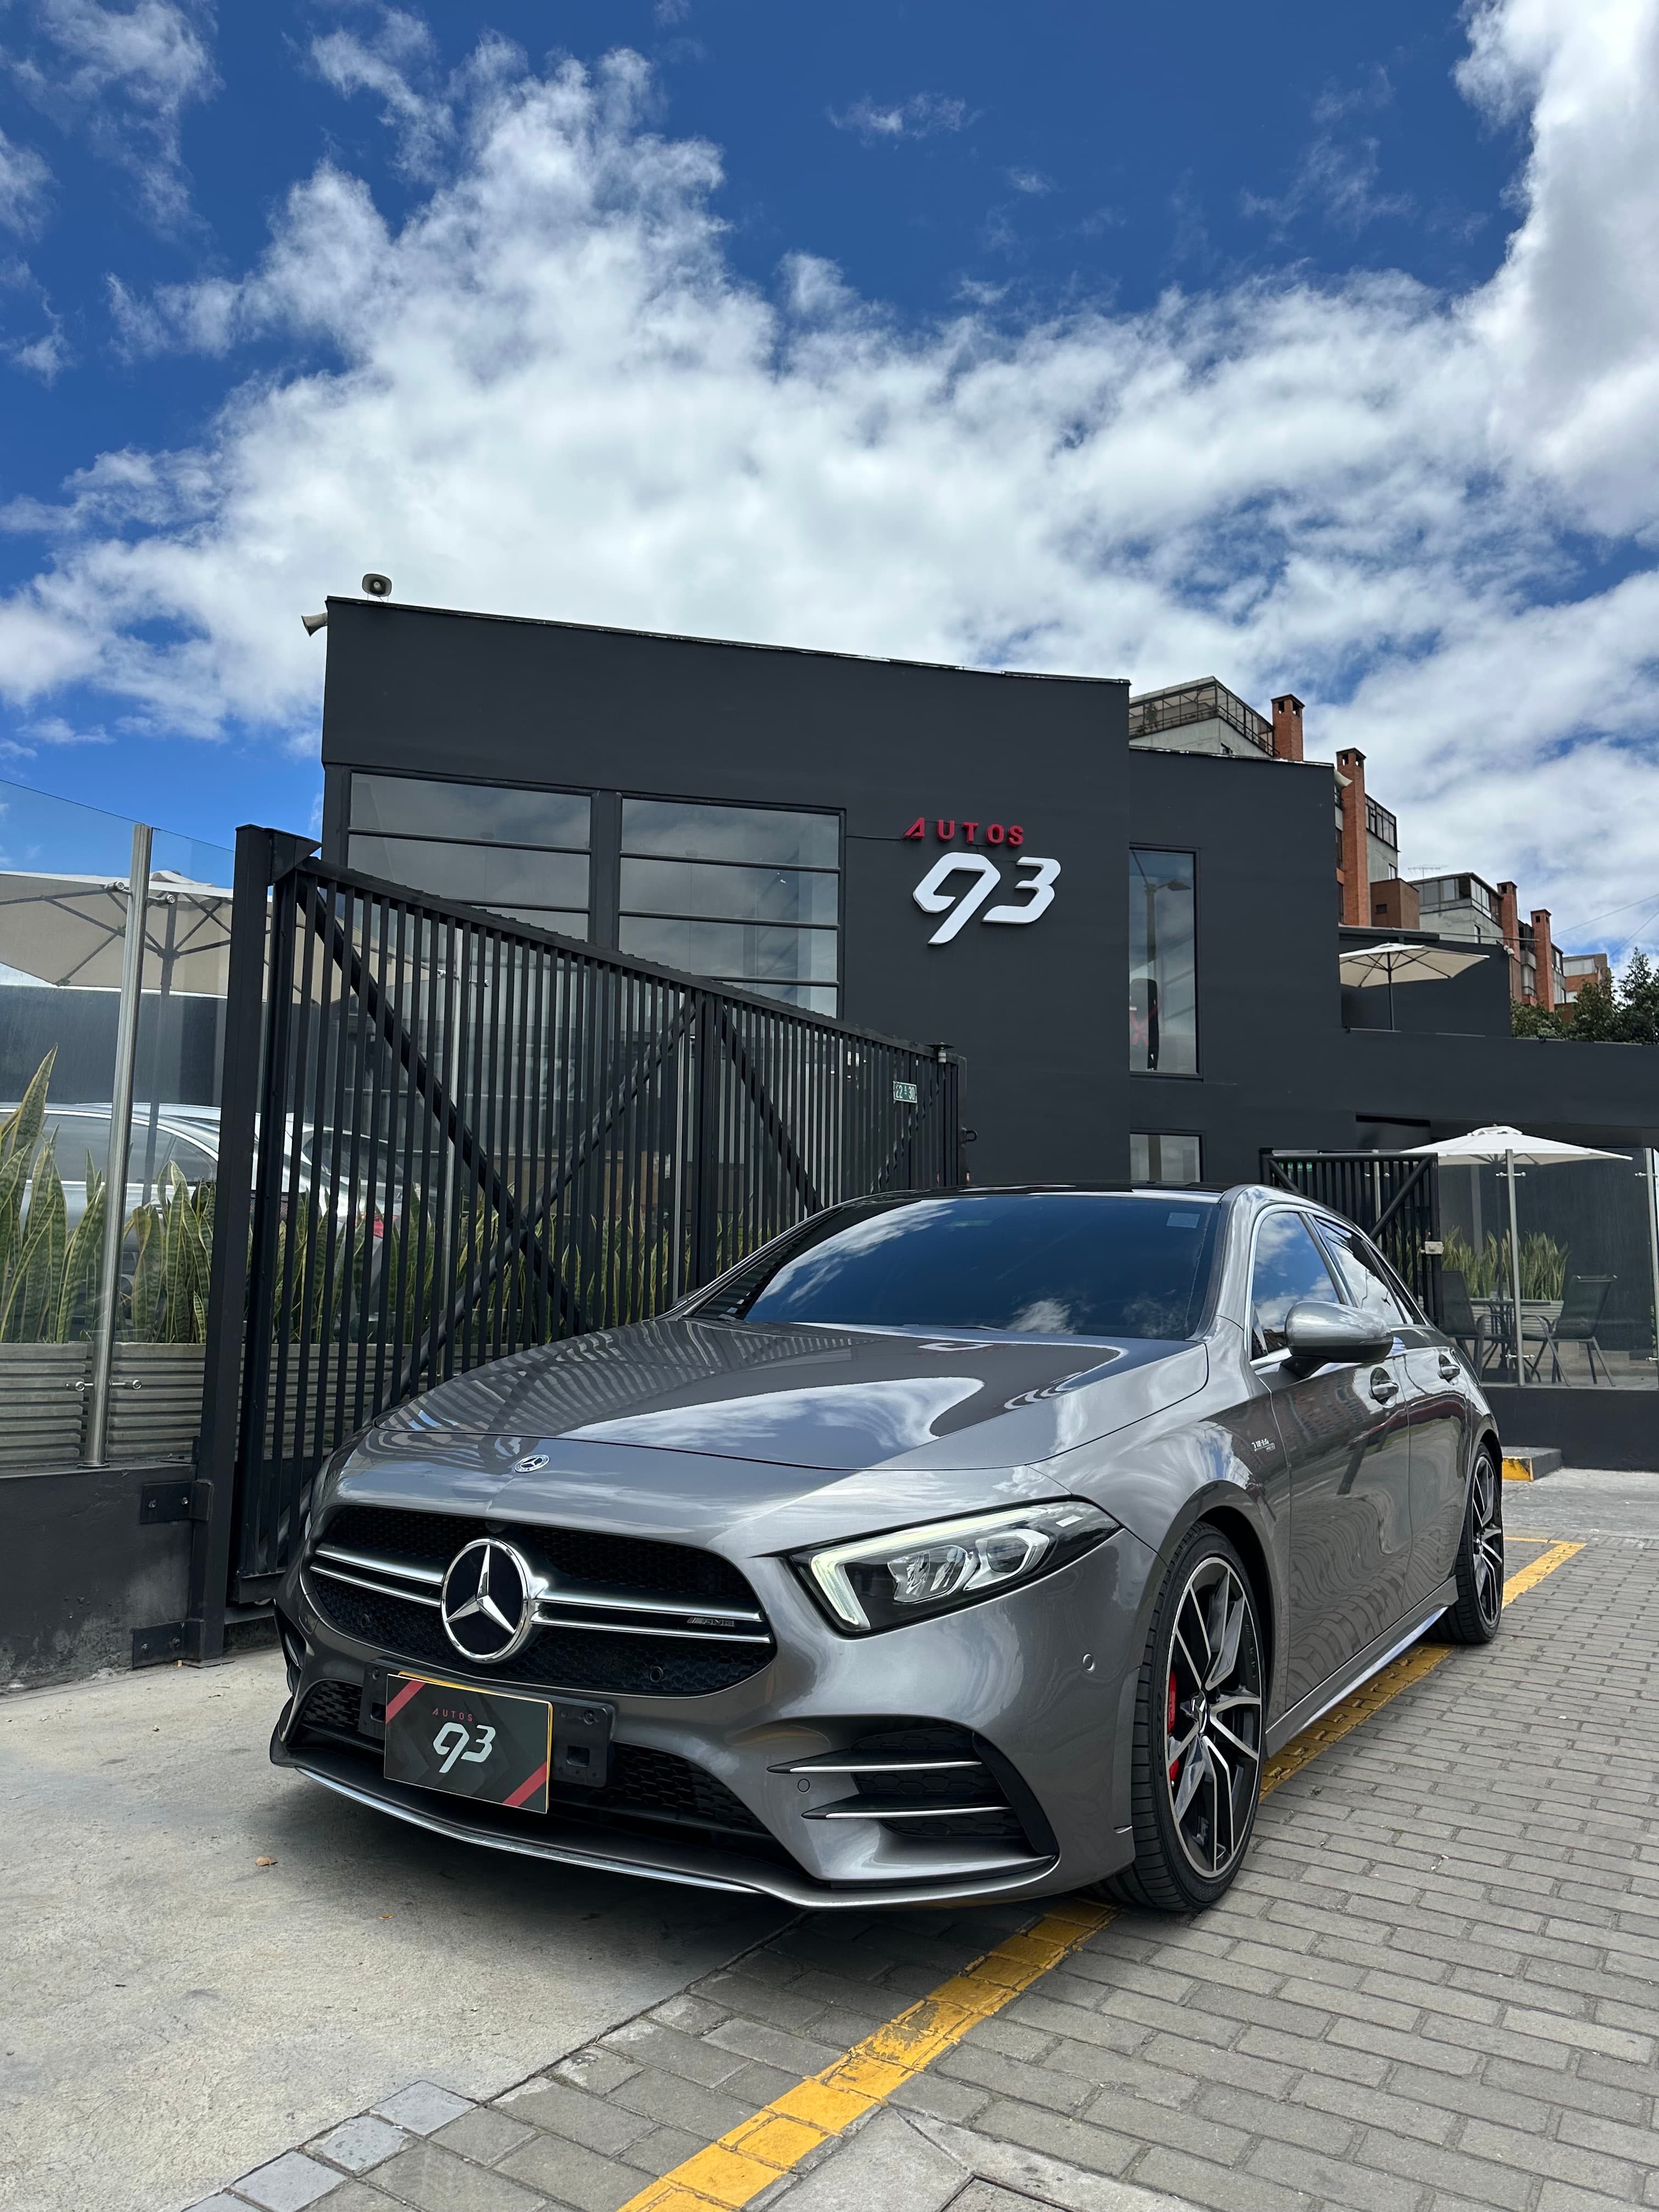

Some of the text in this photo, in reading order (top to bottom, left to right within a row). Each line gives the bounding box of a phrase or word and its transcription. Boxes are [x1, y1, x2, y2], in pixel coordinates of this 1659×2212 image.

[904, 817, 1024, 847] AUTOS
[912, 851, 1062, 945] 93
[432, 1707, 473, 1722] AUTOS
[433, 1722, 496, 1774] 93
